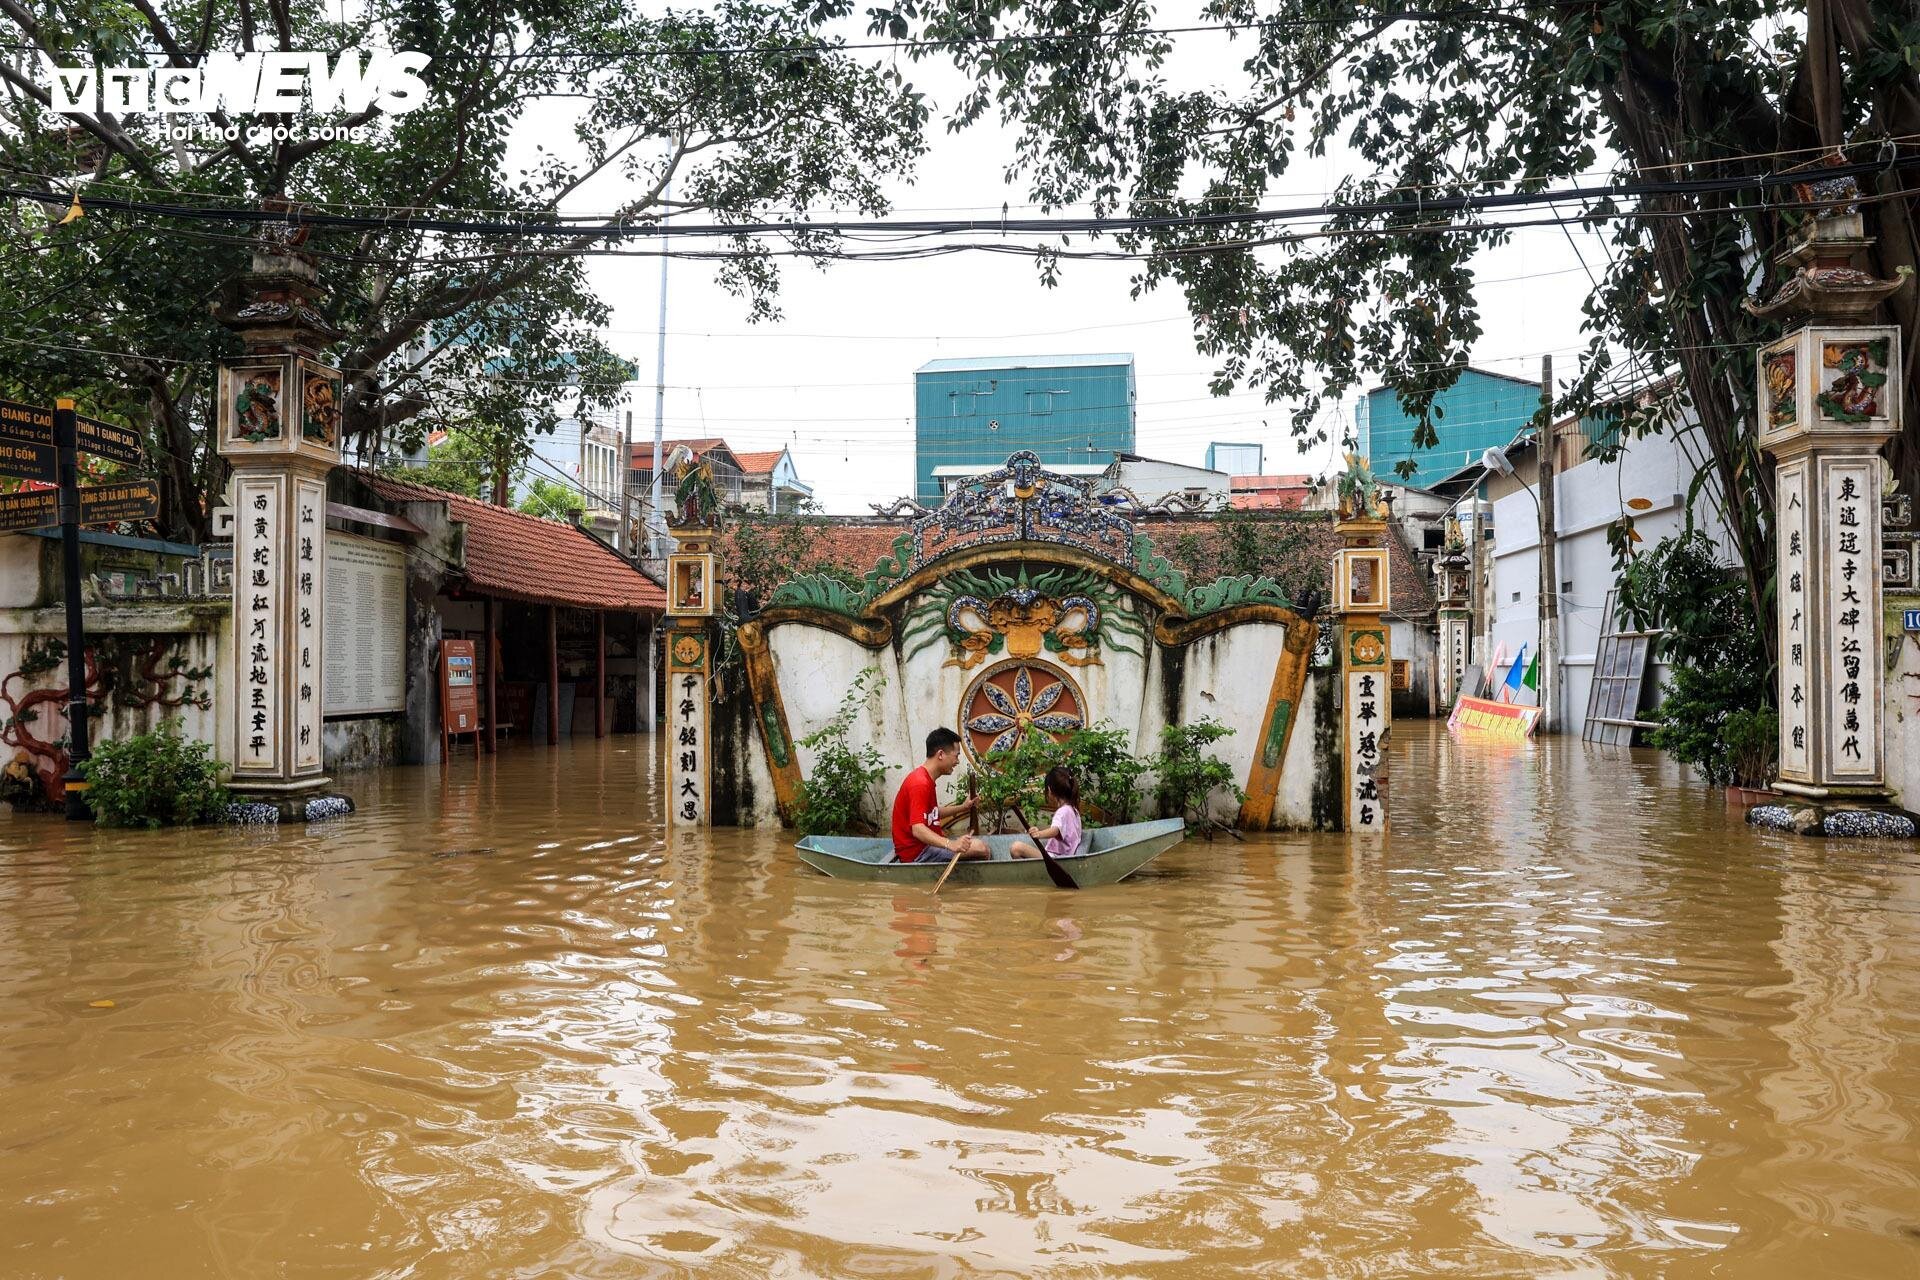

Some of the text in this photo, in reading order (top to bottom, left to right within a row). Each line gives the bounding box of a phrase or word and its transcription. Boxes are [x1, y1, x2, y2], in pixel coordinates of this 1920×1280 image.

[1, 407, 51, 427] GIANG CAO
[9, 425, 35, 439] Giang
[36, 430, 51, 440] Cao
[76, 421, 134, 447] THÔN 1 GIANG CAO
[15, 445, 36, 462] GỐM
[20, 497, 40, 509] GIANG
[41, 494, 54, 506] CAO
[81, 491, 98, 504] CÔNG
